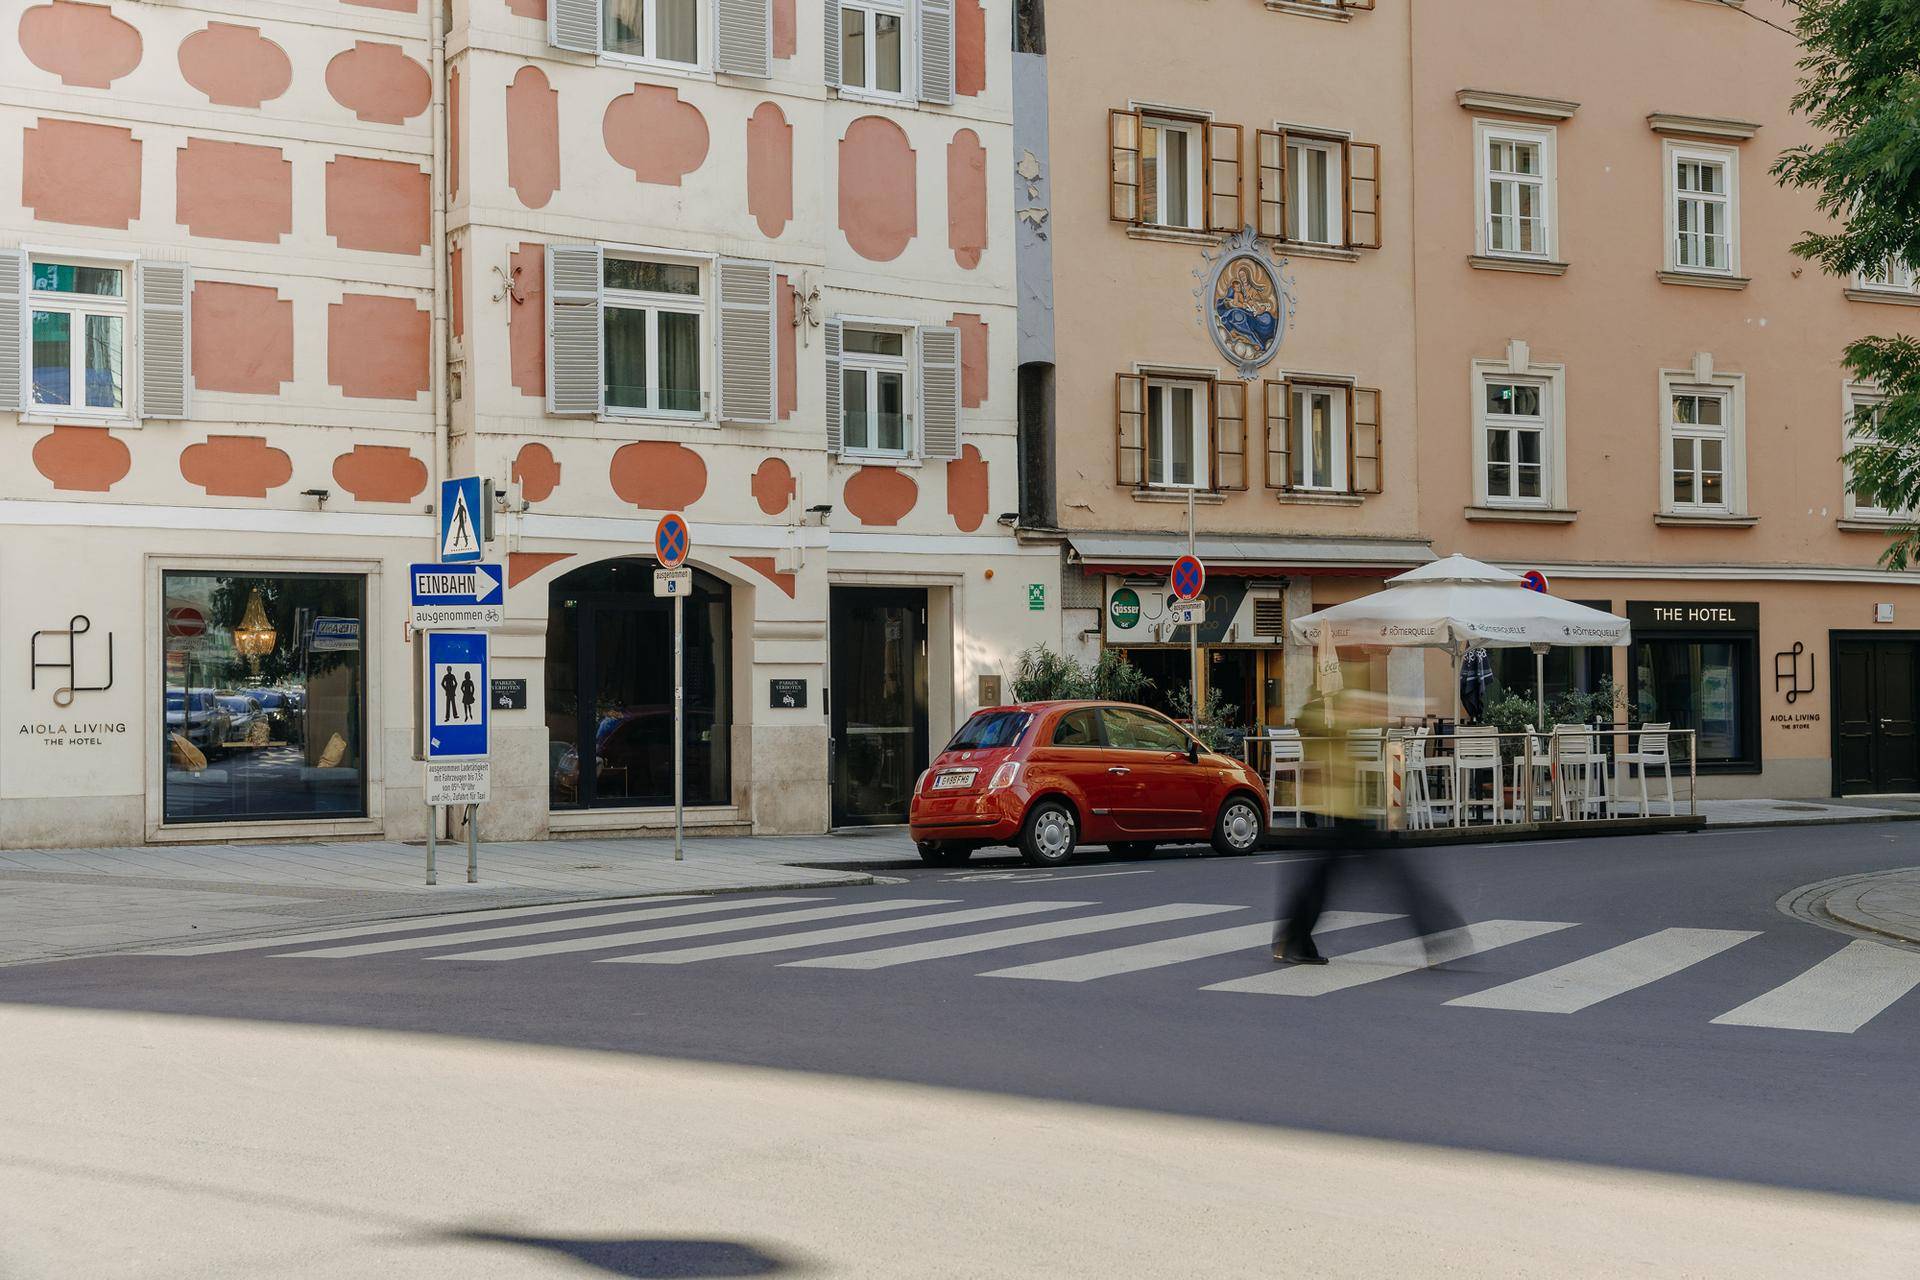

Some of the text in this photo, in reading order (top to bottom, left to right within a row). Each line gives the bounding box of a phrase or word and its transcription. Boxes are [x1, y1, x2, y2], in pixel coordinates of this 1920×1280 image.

[419, 575, 475, 594] EINBAHN
[1111, 601, 1139, 616] Gösser
[1653, 607, 1736, 621] THE HOTEL
[416, 610, 483, 624] ausgenommen
[1770, 713, 1820, 722] AIOLA LIVING
[20, 723, 126, 734] AIOLA LIVING
[44, 737, 102, 746] THE HOTEL
